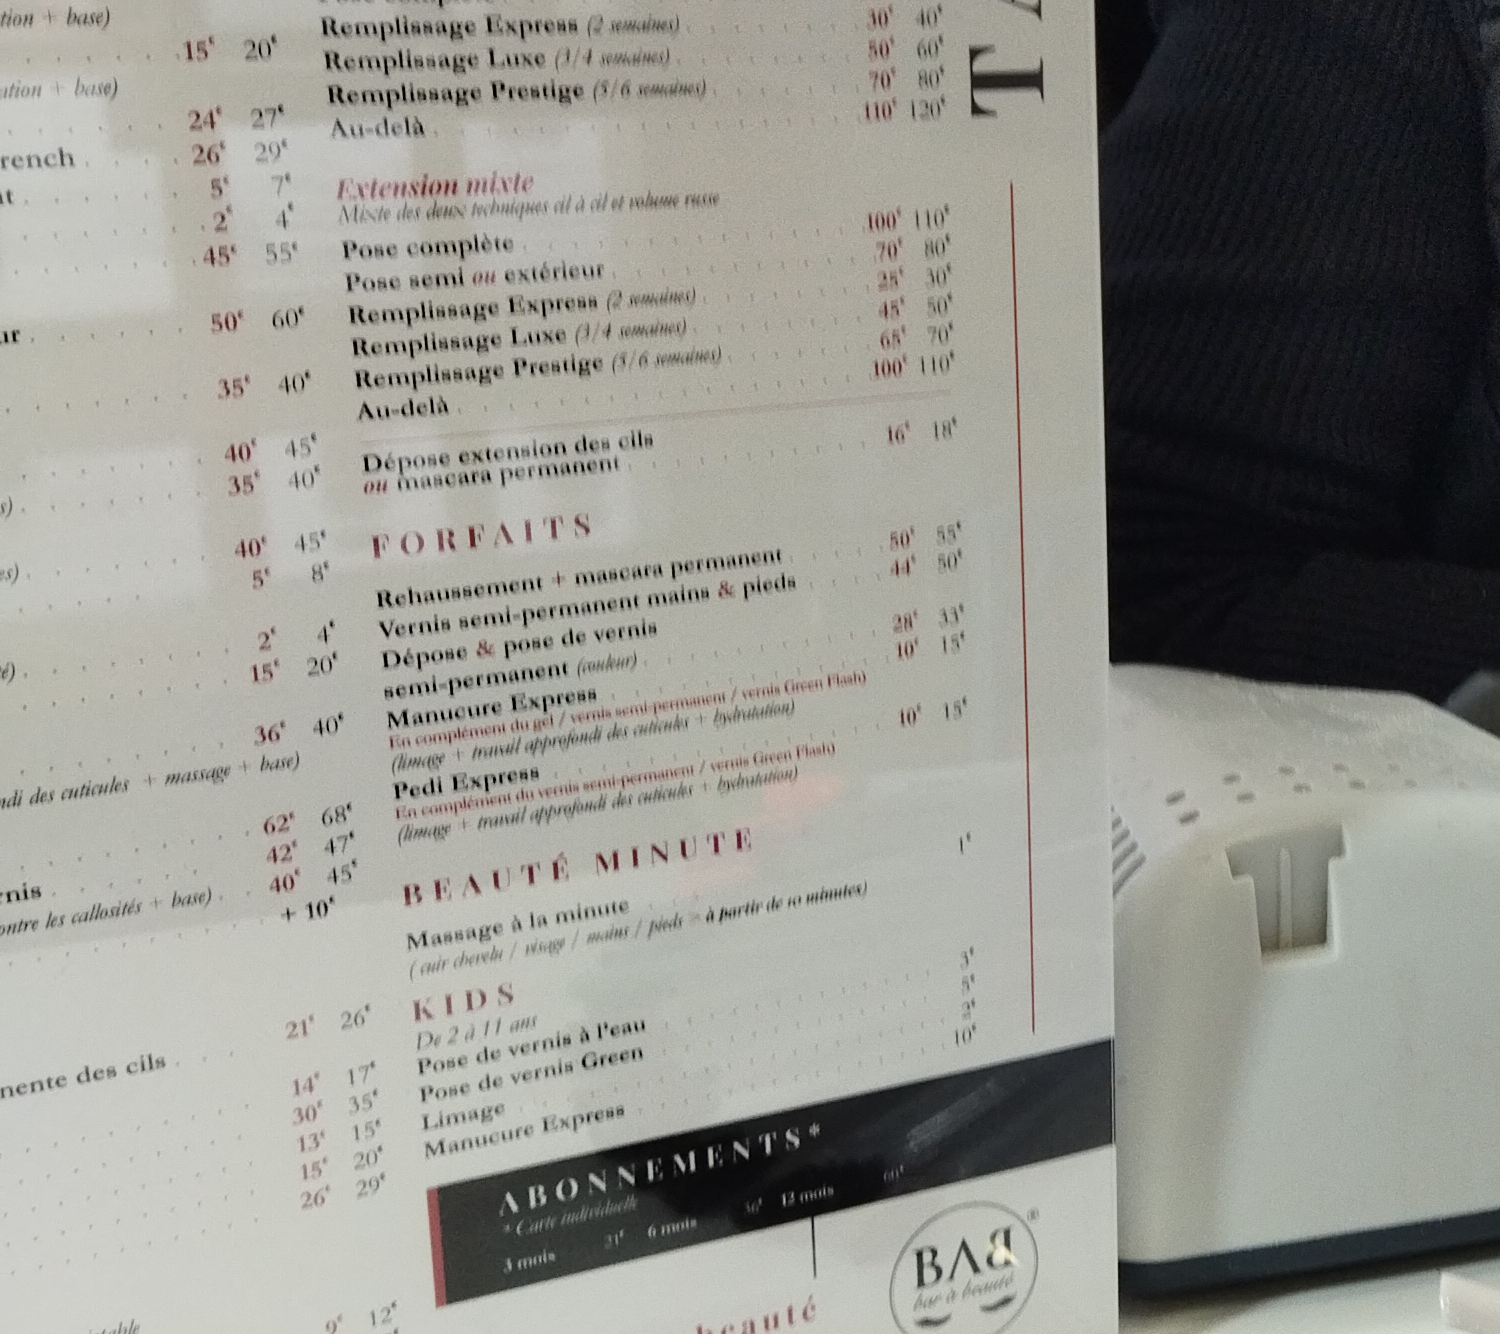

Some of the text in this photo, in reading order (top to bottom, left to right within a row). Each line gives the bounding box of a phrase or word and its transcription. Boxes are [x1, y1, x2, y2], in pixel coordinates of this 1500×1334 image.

[320, 15, 578, 43] Remplissage Express
[323, 47, 546, 77] Remplissage Luxe
[327, 79, 585, 111] Remplissage Prestige
[330, 117, 425, 140] Au-delà
[336, 169, 535, 202] Extension mixte
[341, 234, 514, 265] Pose complète
[345, 262, 605, 294] Pose semi ou extérieur
[347, 292, 599, 330] Remplissage Express
[350, 326, 567, 360] Remplissage Luxe
[354, 355, 604, 394] Remplissage Prestige
[357, 396, 449, 422] Au-delà
[360, 429, 655, 476] Dépose extension des cils
[363, 455, 622, 495] ou mascara permanent
[371, 511, 593, 560] FORFAITS
[375, 574, 544, 610] Rehaussement
[574, 562, 665, 586] mascara
[669, 547, 783, 580] permanent
[379, 573, 798, 640] Vernis semi-permanent mains & pieds
[381, 620, 658, 676] Dépose & pose de vernis
[383, 661, 569, 700] semi-permanent
[386, 686, 597, 729] Manucure Express
[60, 751, 301, 803] cuticules massage base)
[392, 766, 540, 802] Pedi Express
[402, 827, 754, 907] BEAUTÉ MINUTE
[45, 887, 213, 930] les callosités base)
[406, 899, 630, 953] Massage à la minute
[411, 981, 516, 1025] KIDS
[415, 1015, 538, 1053] De 2 à 11 ans
[416, 1018, 646, 1077] Pose de vernis à l'eau
[76, 1053, 167, 1085] des cils
[419, 1045, 644, 1104] Pose de vernis Green
[421, 1101, 505, 1131] Limage
[424, 1104, 626, 1160] Manucure Express
